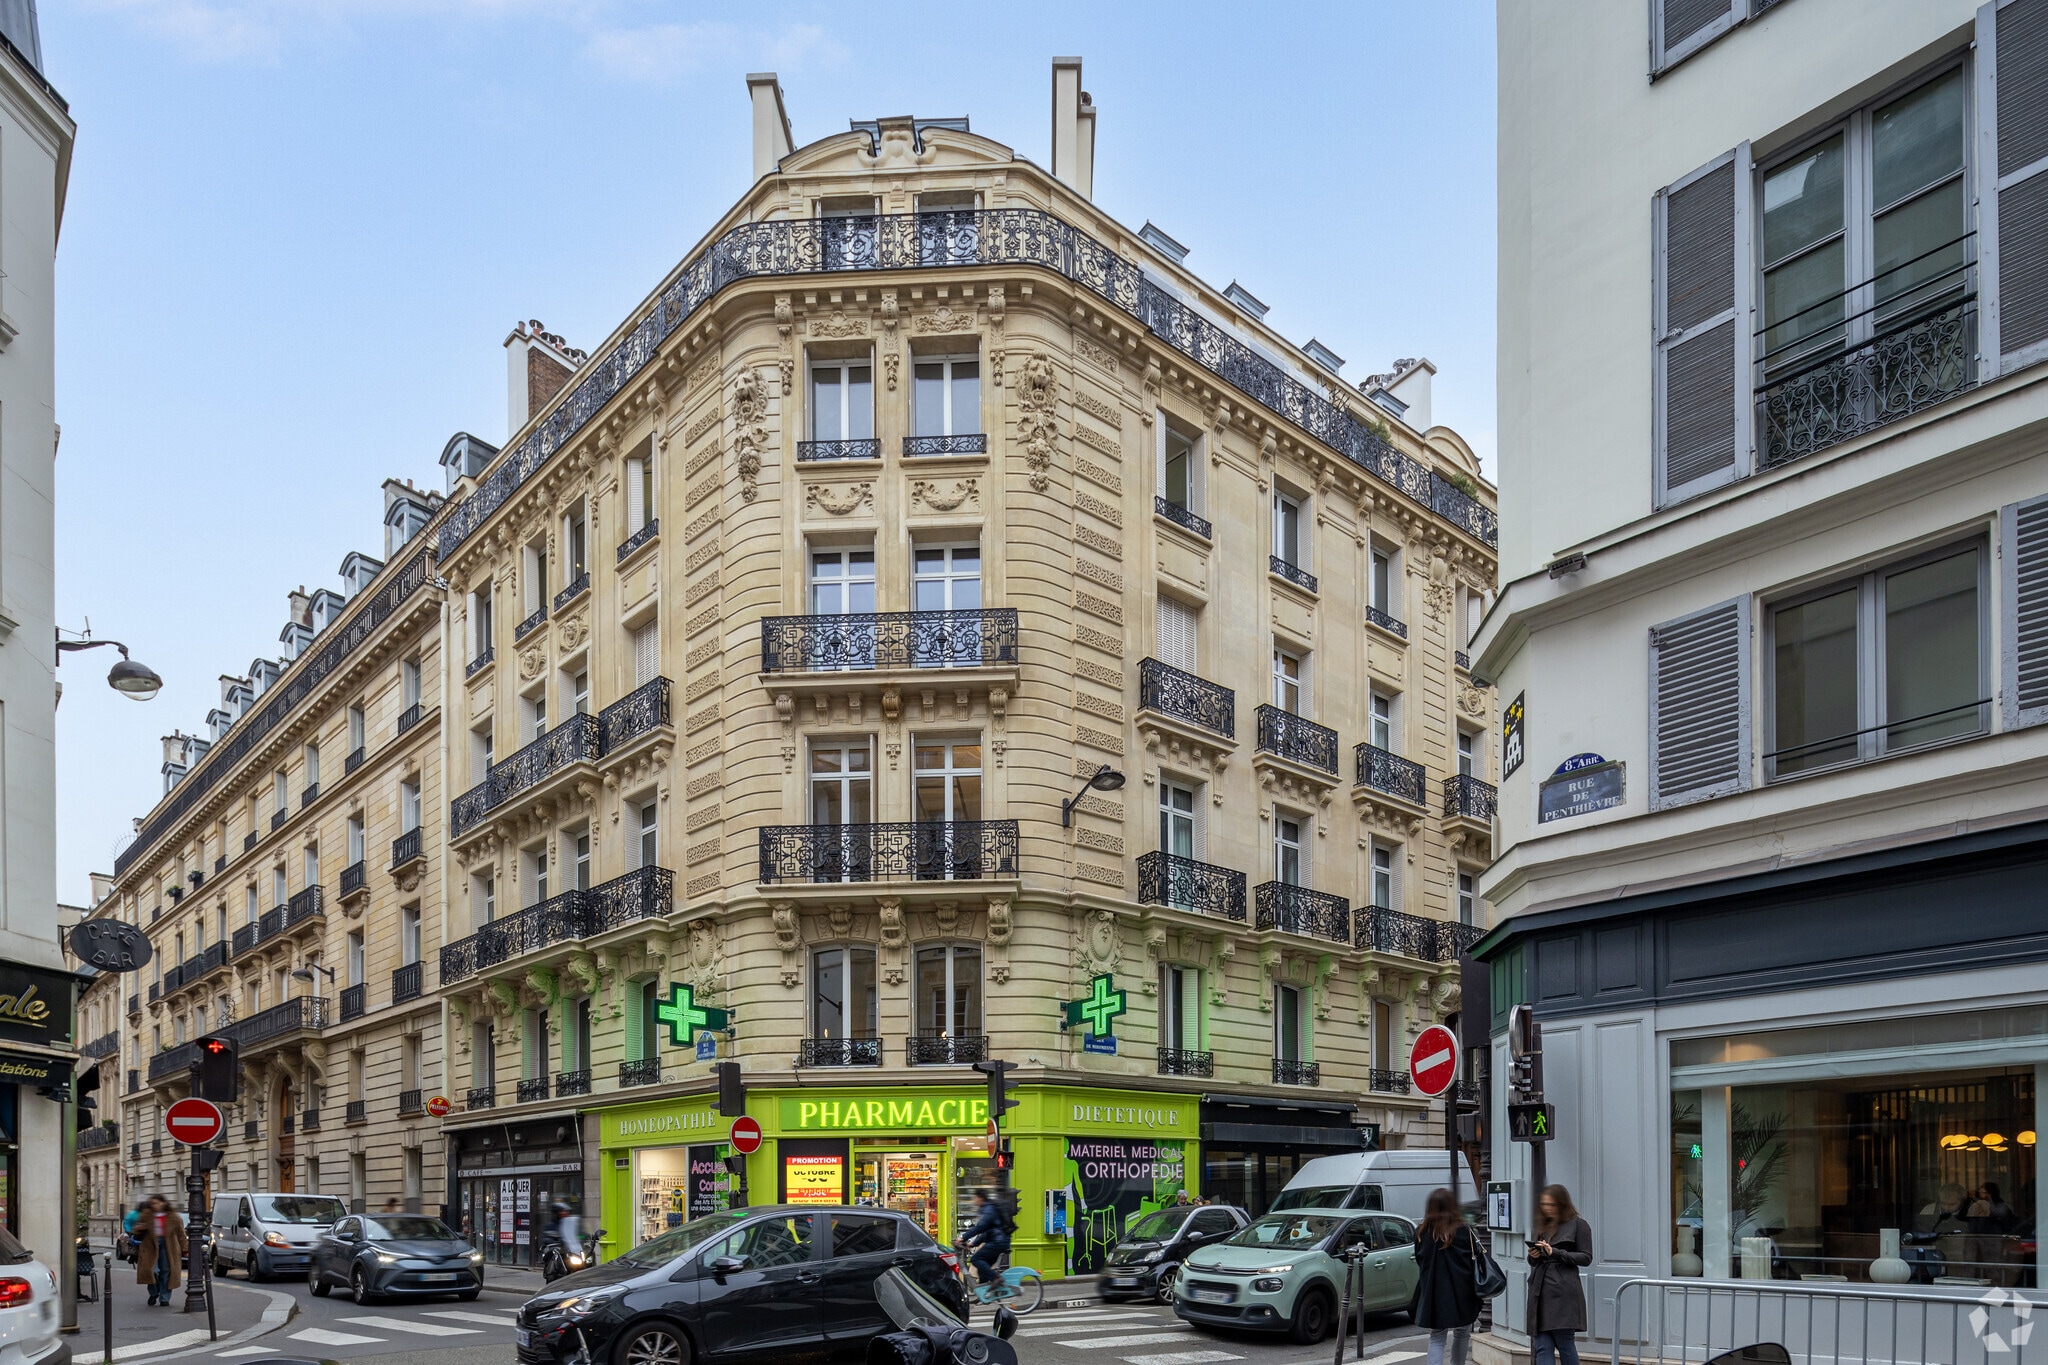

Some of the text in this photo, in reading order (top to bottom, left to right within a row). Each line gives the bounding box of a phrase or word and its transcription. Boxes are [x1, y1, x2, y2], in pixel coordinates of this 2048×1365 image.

[1568, 777, 1595, 793] RUE
[1572, 791, 1590, 803] DE
[1544, 795, 1620, 821] PENTHIÈVRE
[91, 949, 135, 968] BAR
[799, 1098, 988, 1128] PHARMACIE
[1072, 1104, 1179, 1129] DIETETIQUE
[619, 1111, 716, 1136] HOMEOPATHIE
[1070, 1144, 1183, 1159] MATERIEL MEDICAL
[562, 1163, 578, 1171] BAR
[1085, 1162, 1183, 1179] ORTHOPEDIE
